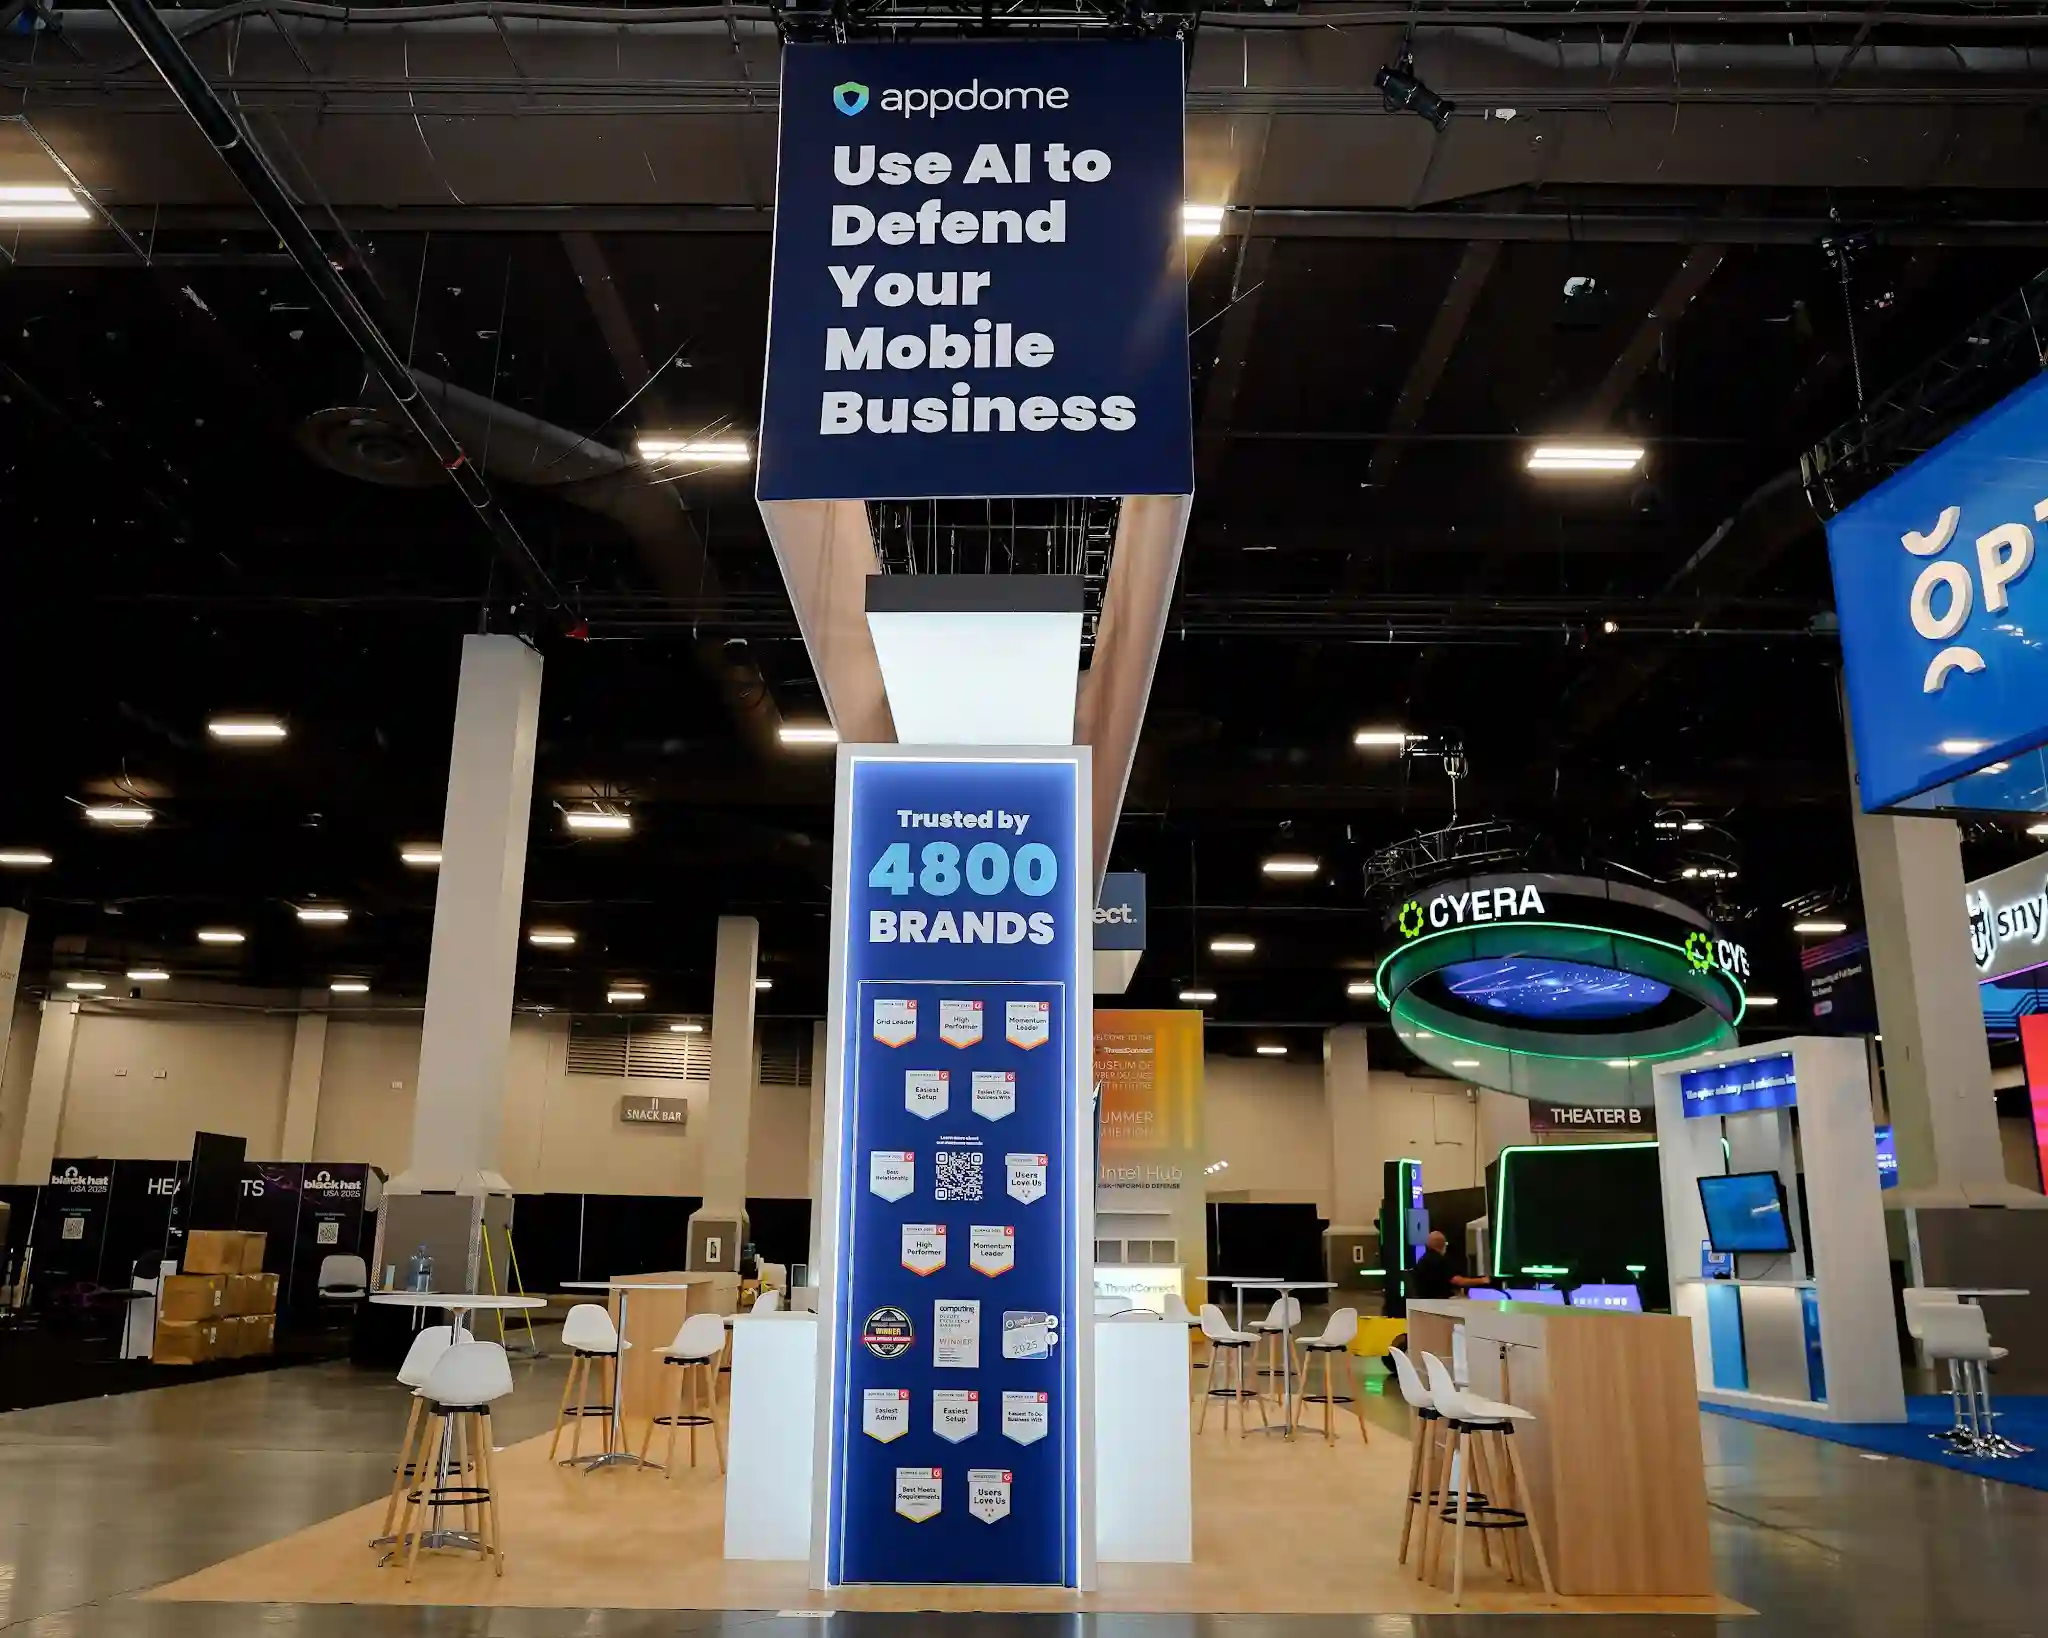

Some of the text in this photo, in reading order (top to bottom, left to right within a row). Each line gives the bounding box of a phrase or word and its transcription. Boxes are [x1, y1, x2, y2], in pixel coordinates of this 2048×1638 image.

[880, 78, 1069, 118] appdome
[833, 142, 1112, 186] Use AI to
[831, 199, 1066, 247] Defend
[828, 264, 991, 308] Your
[824, 318, 1055, 371] Mobile
[819, 381, 1137, 435] Business
[1901, 497, 2048, 693] OP
[896, 809, 1030, 835] Trusted by
[868, 841, 1058, 896] 4800
[1429, 884, 1545, 929] CYERA
[1998, 885, 2048, 939] sny
[869, 910, 1055, 945] BRANDS
[876, 1018, 914, 1026] Grid Leader
[953, 1016, 970, 1024] High
[1008, 1017, 1047, 1025] Momentum
[944, 1023, 978, 1031] Performer
[915, 1086, 939, 1094] Easiest
[626, 1109, 682, 1122] SNACK BAR
[1100, 1111, 1153, 1124] UMMER
[1550, 1107, 1642, 1124] THEATER B
[1015, 1171, 1038, 1179] Users
[1100, 1164, 1183, 1181] Intel Hub
[51, 1175, 109, 1185] black hat
[303, 1179, 362, 1190] black hat
[1011, 1179, 1042, 1187] Love Us
[70, 1185, 108, 1193] USA 2025
[323, 1189, 361, 1198] USA 2025
[916, 1241, 933, 1249] High
[907, 1248, 941, 1256] Performer
[980, 1249, 1004, 1257] Leader
[939, 1305, 975, 1314] computing
[875, 1327, 901, 1335] WINNER
[939, 1338, 972, 1346] WINNER
[1012, 1340, 1038, 1355] 2025
[943, 1407, 968, 1415] Easiest
[945, 1415, 967, 1424] Setup
[902, 1486, 936, 1494] Best Meets
[978, 1488, 1002, 1497] Users
[897, 1493, 940, 1501] Requirements
[973, 1496, 1006, 1505] Love Us
